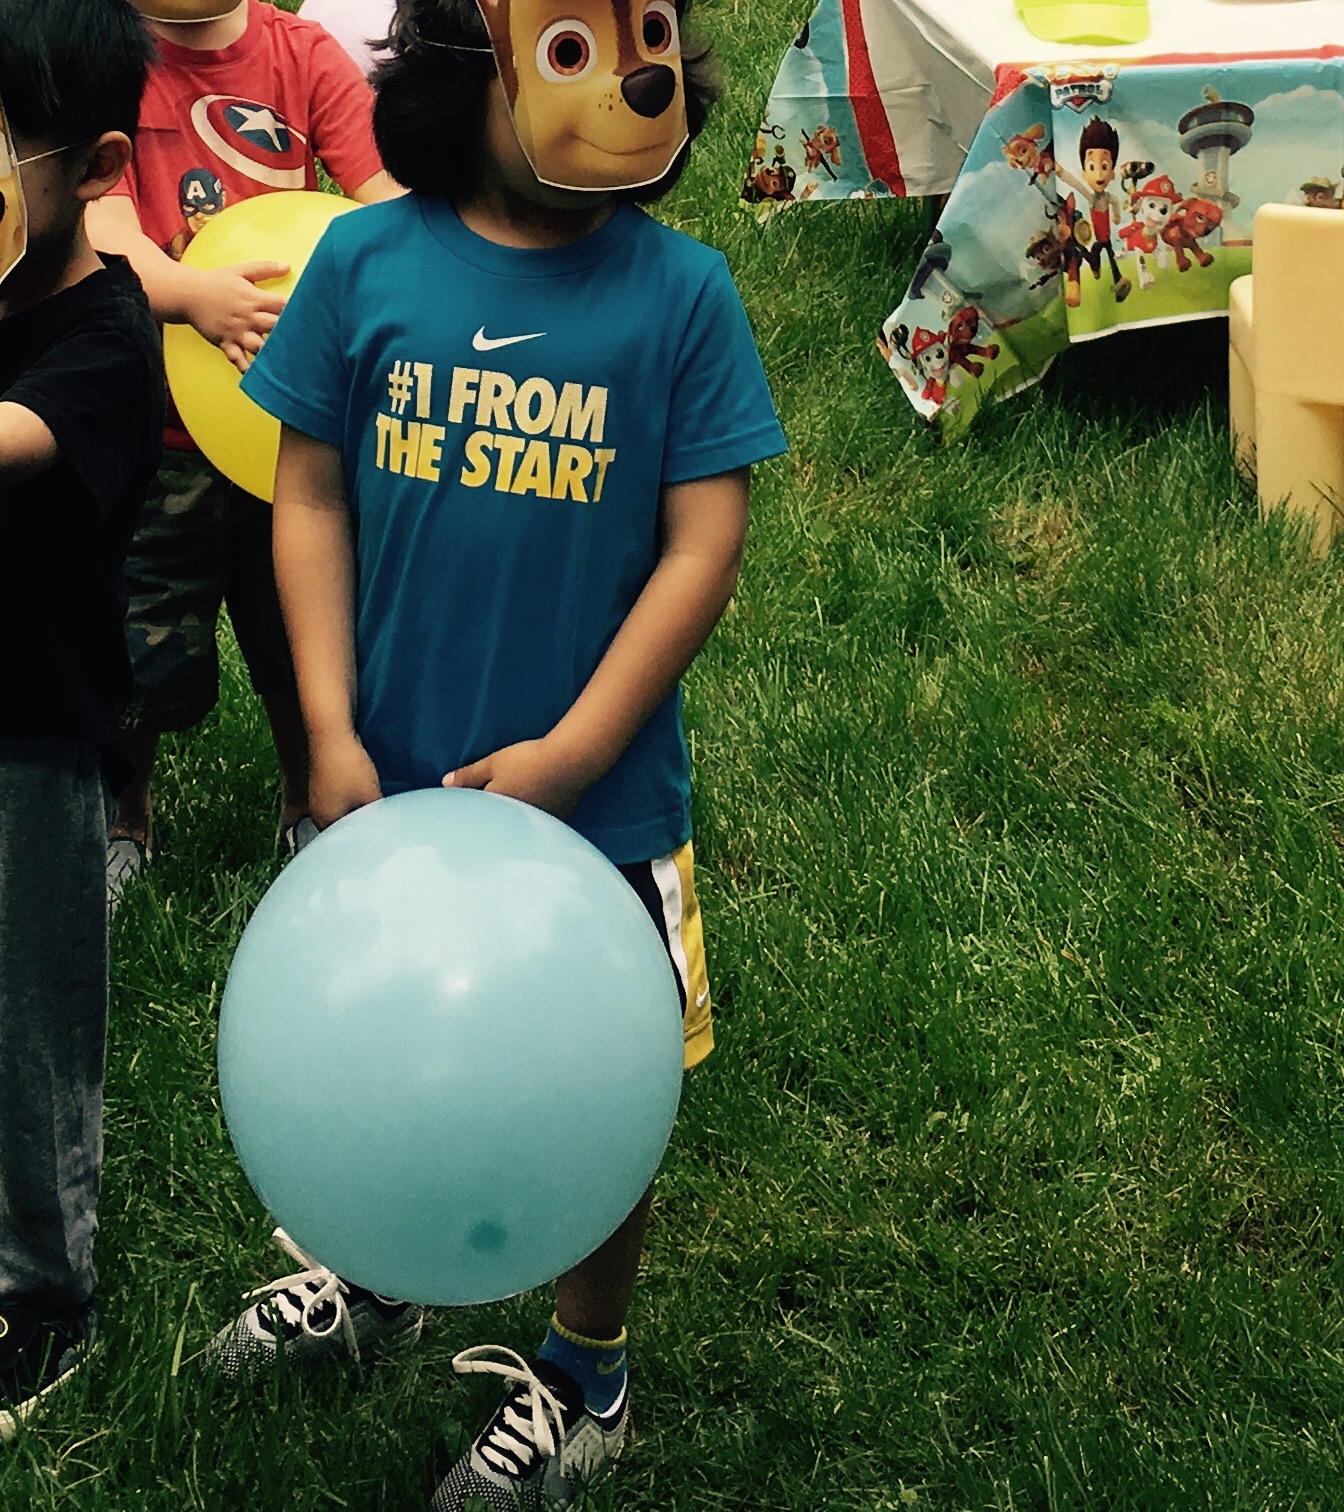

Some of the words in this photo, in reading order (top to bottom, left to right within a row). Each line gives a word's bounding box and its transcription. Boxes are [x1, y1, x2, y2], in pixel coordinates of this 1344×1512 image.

[186, 179, 207, 200] A
[387, 359, 434, 419] #1
[447, 366, 609, 443] FROM
[375, 412, 446, 482] THE
[459, 430, 617, 504] START
